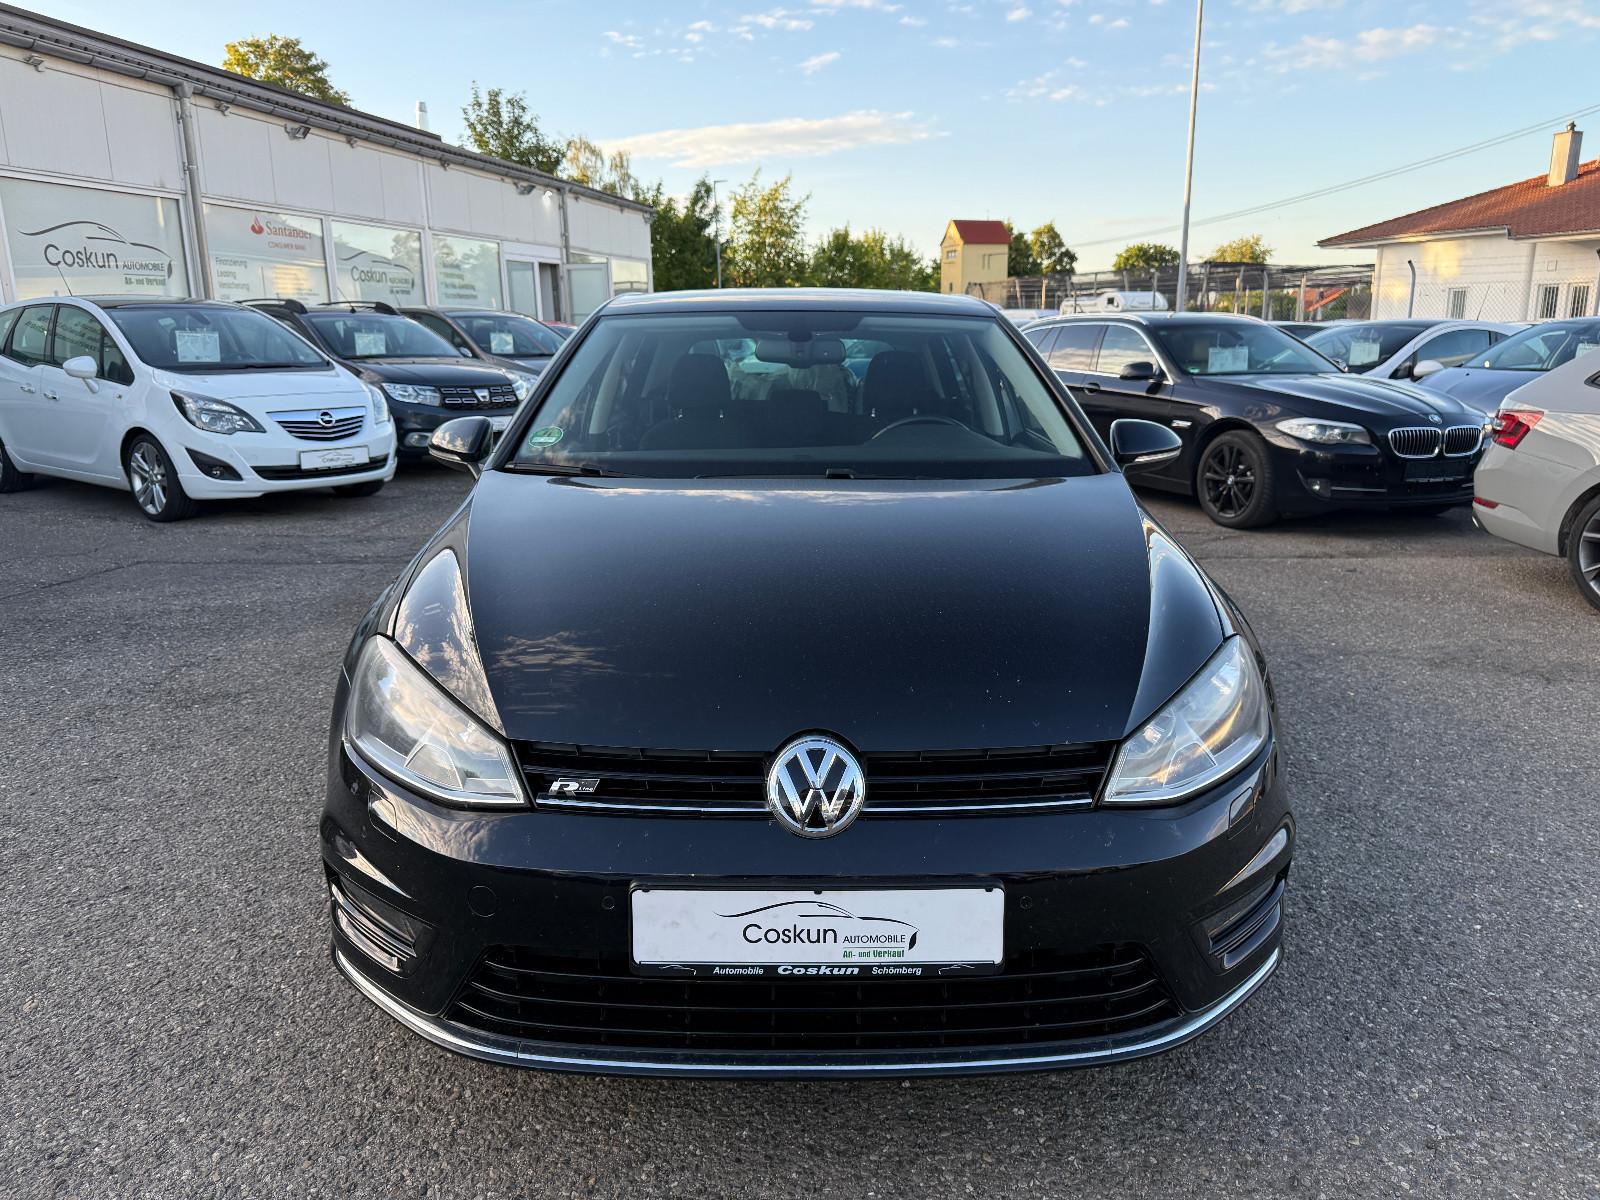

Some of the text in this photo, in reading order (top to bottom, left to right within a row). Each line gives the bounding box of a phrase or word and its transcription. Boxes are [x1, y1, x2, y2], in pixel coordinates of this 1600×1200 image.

[265, 220, 312, 240] Santander
[43, 243, 166, 272] Coskun AUTOMOBILE
[350, 265, 388, 284] Coskun
[742, 923, 906, 944] Coskun AUTOMOBILE
[842, 949, 905, 959] An- und Verkauf
[713, 965, 922, 976] Automobile Coskun Schömberg
